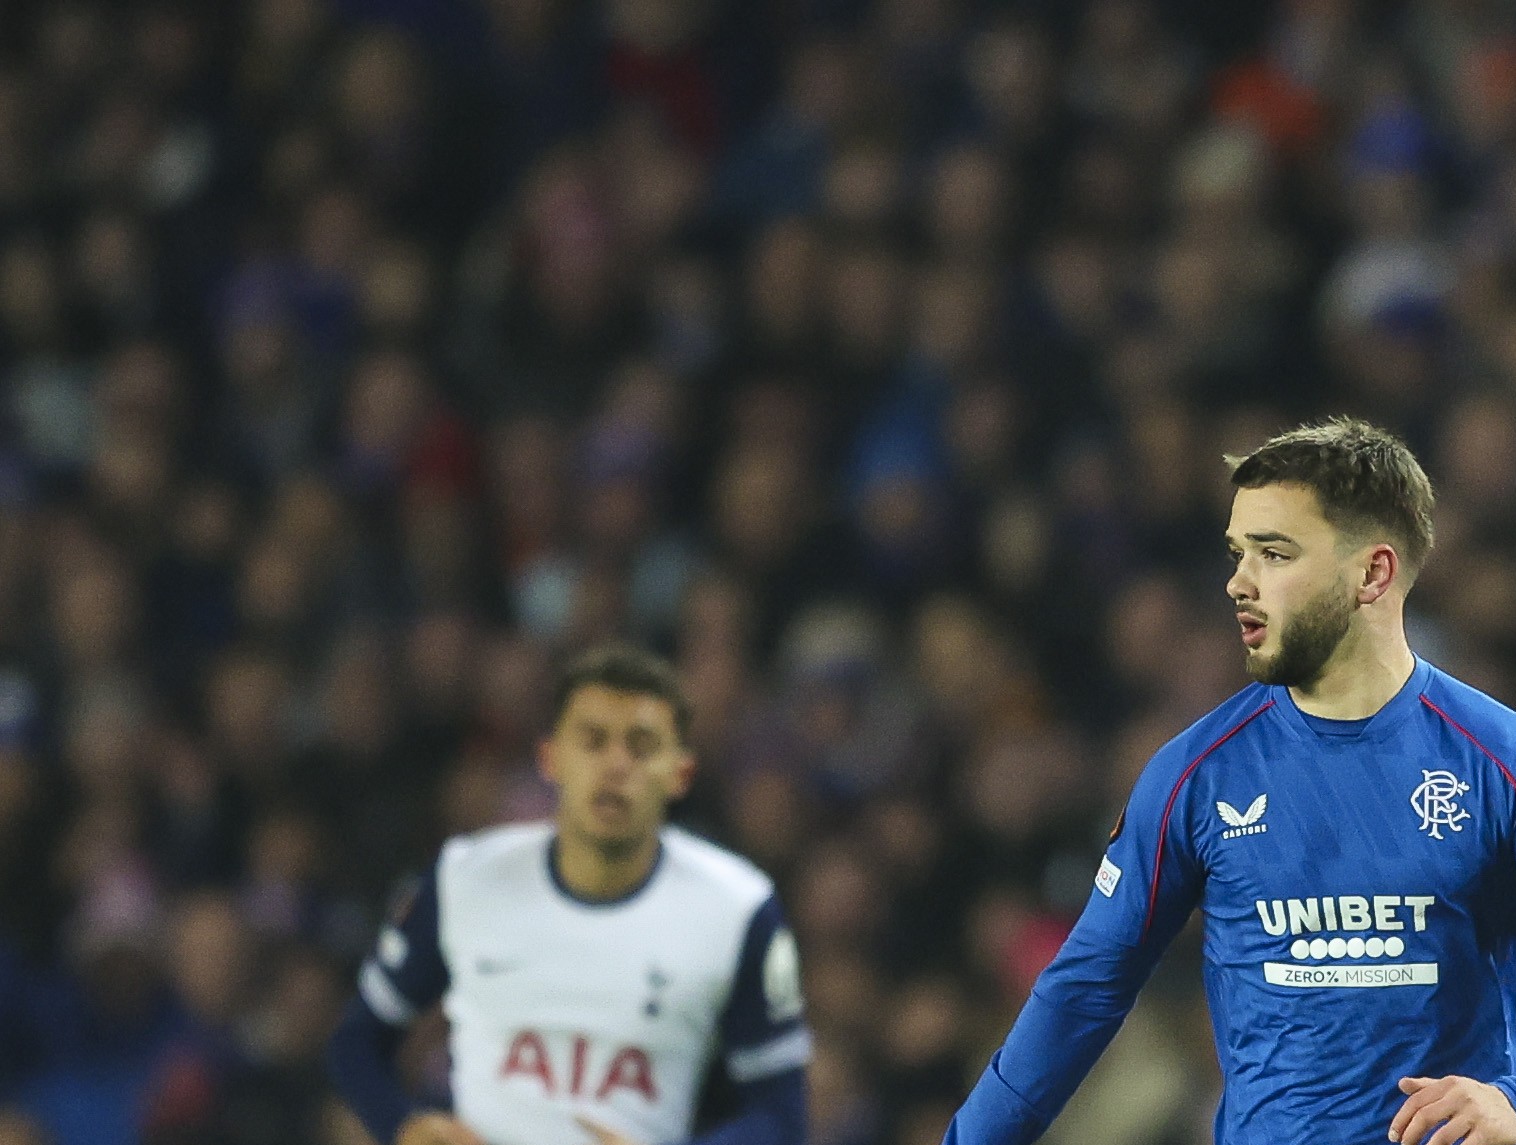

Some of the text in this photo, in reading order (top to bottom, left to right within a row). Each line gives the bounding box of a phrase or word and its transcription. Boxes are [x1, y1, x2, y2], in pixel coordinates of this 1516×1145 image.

[1222, 824, 1268, 840] CASTORE
[1256, 895, 1436, 936] UNIBET
[1285, 968, 1413, 984] ZERO% MISSION
[497, 1028, 661, 1103] AIA
